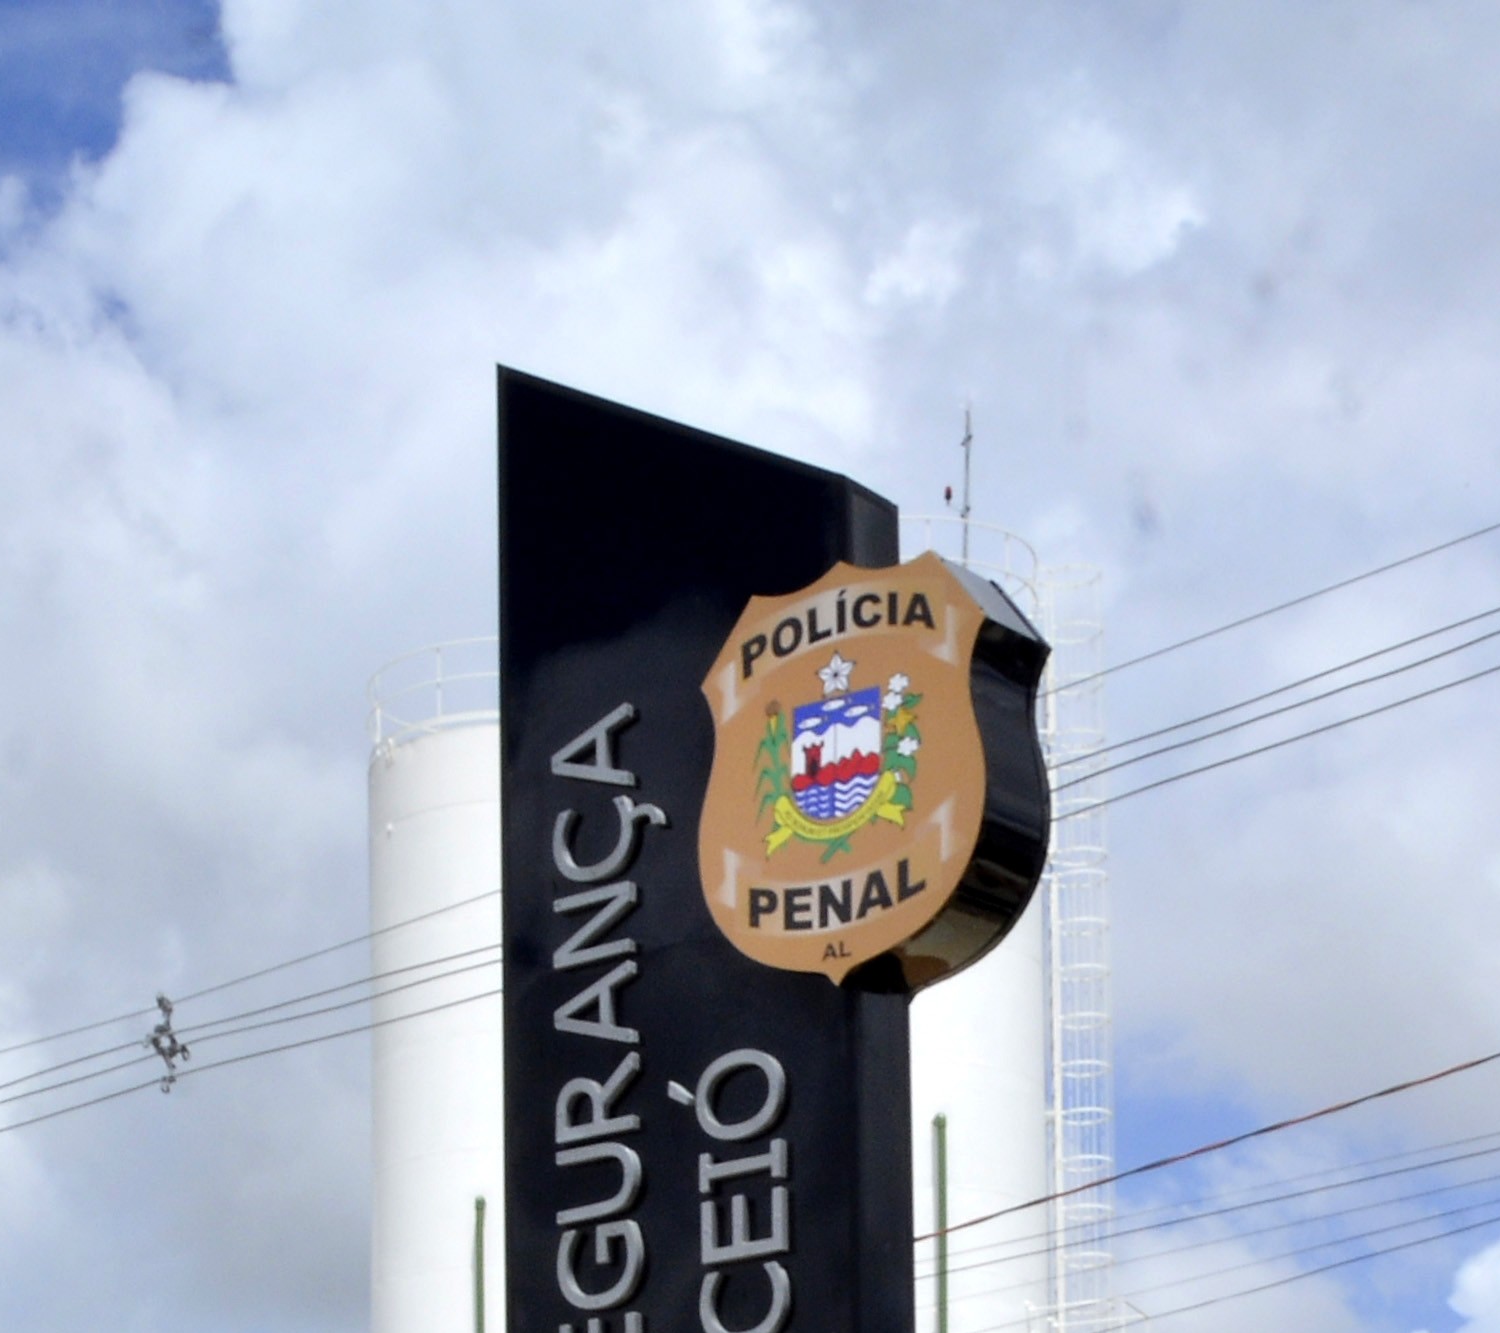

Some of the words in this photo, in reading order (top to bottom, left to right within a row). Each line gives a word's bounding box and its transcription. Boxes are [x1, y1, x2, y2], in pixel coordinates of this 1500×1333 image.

[741, 589, 935, 679] POLÍCIA
[749, 858, 926, 931] PENAL
[823, 941, 851, 961] AL
